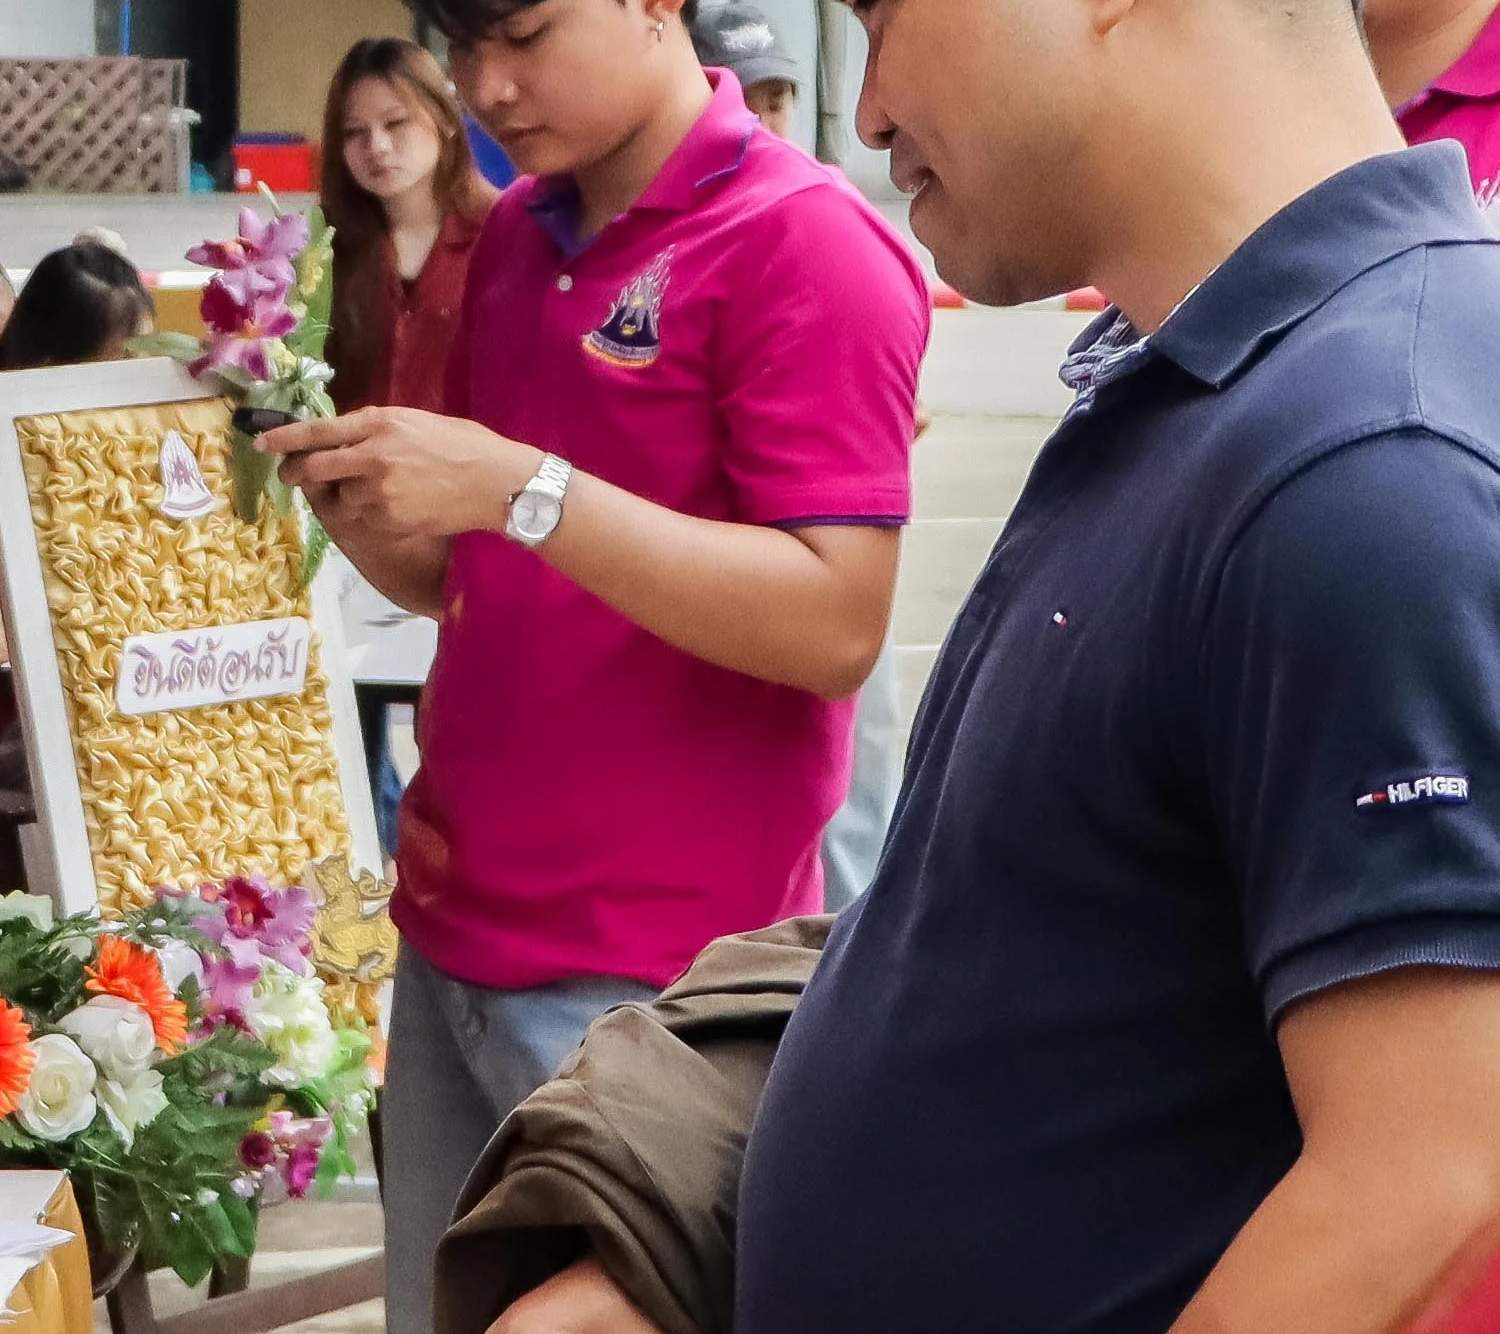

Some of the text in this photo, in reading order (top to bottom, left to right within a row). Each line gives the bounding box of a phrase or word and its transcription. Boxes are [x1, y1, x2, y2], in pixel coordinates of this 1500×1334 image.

[131, 618, 301, 697] ยินดีต้อนรับ
[1387, 774, 1468, 805] HILFIGER
